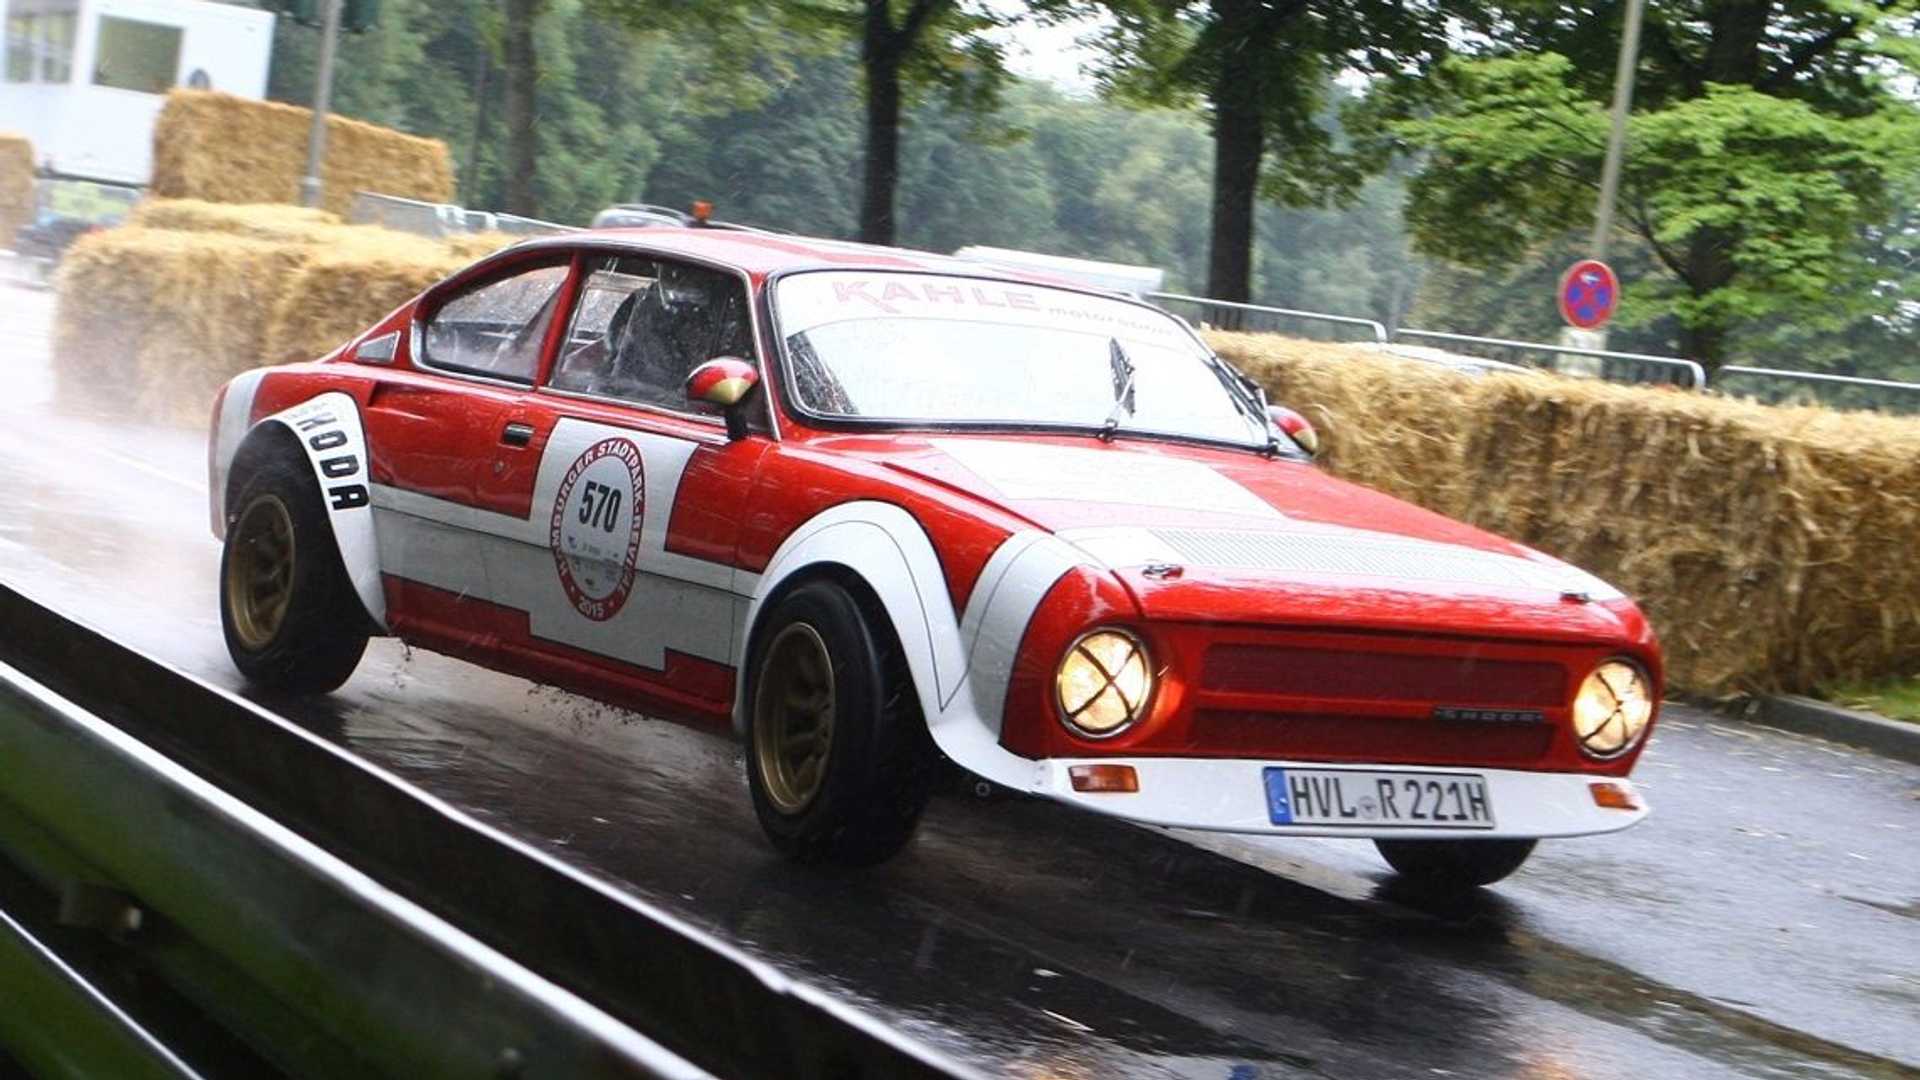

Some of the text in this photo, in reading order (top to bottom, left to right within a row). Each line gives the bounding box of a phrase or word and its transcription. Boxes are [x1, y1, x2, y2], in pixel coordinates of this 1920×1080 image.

[832, 281, 1041, 314] KAHLE
[287, 402, 370, 510] KODA
[578, 480, 622, 533] 570
[597, 439, 644, 594] STADTPARK-REVIAL
[578, 597, 605, 618] 2015
[1288, 775, 1492, 821] HVL R 221H
